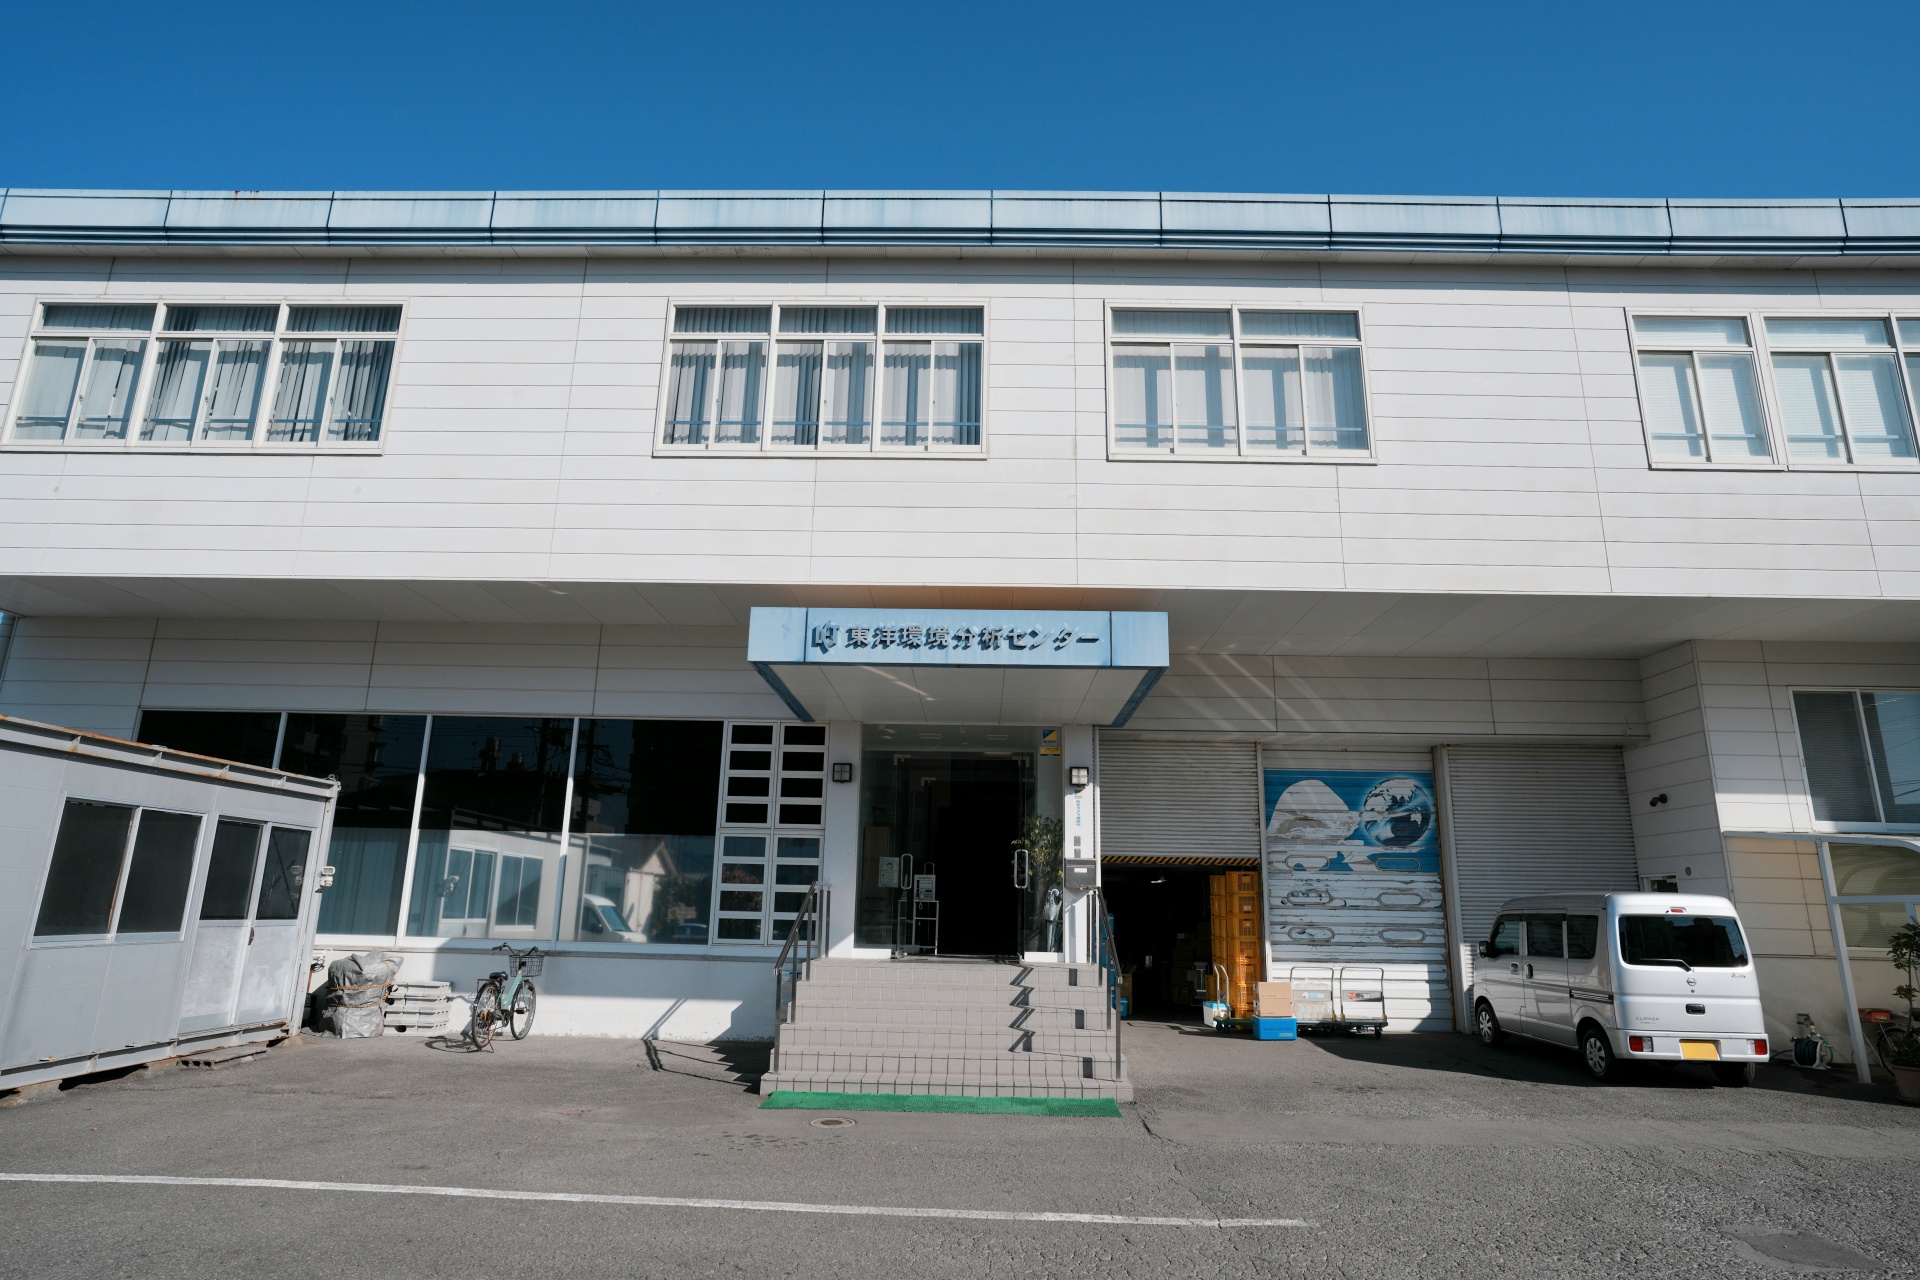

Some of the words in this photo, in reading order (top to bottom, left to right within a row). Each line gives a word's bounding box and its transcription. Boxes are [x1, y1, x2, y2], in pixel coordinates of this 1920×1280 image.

[847, 625, 1100, 649] 東洋環境分析センター
